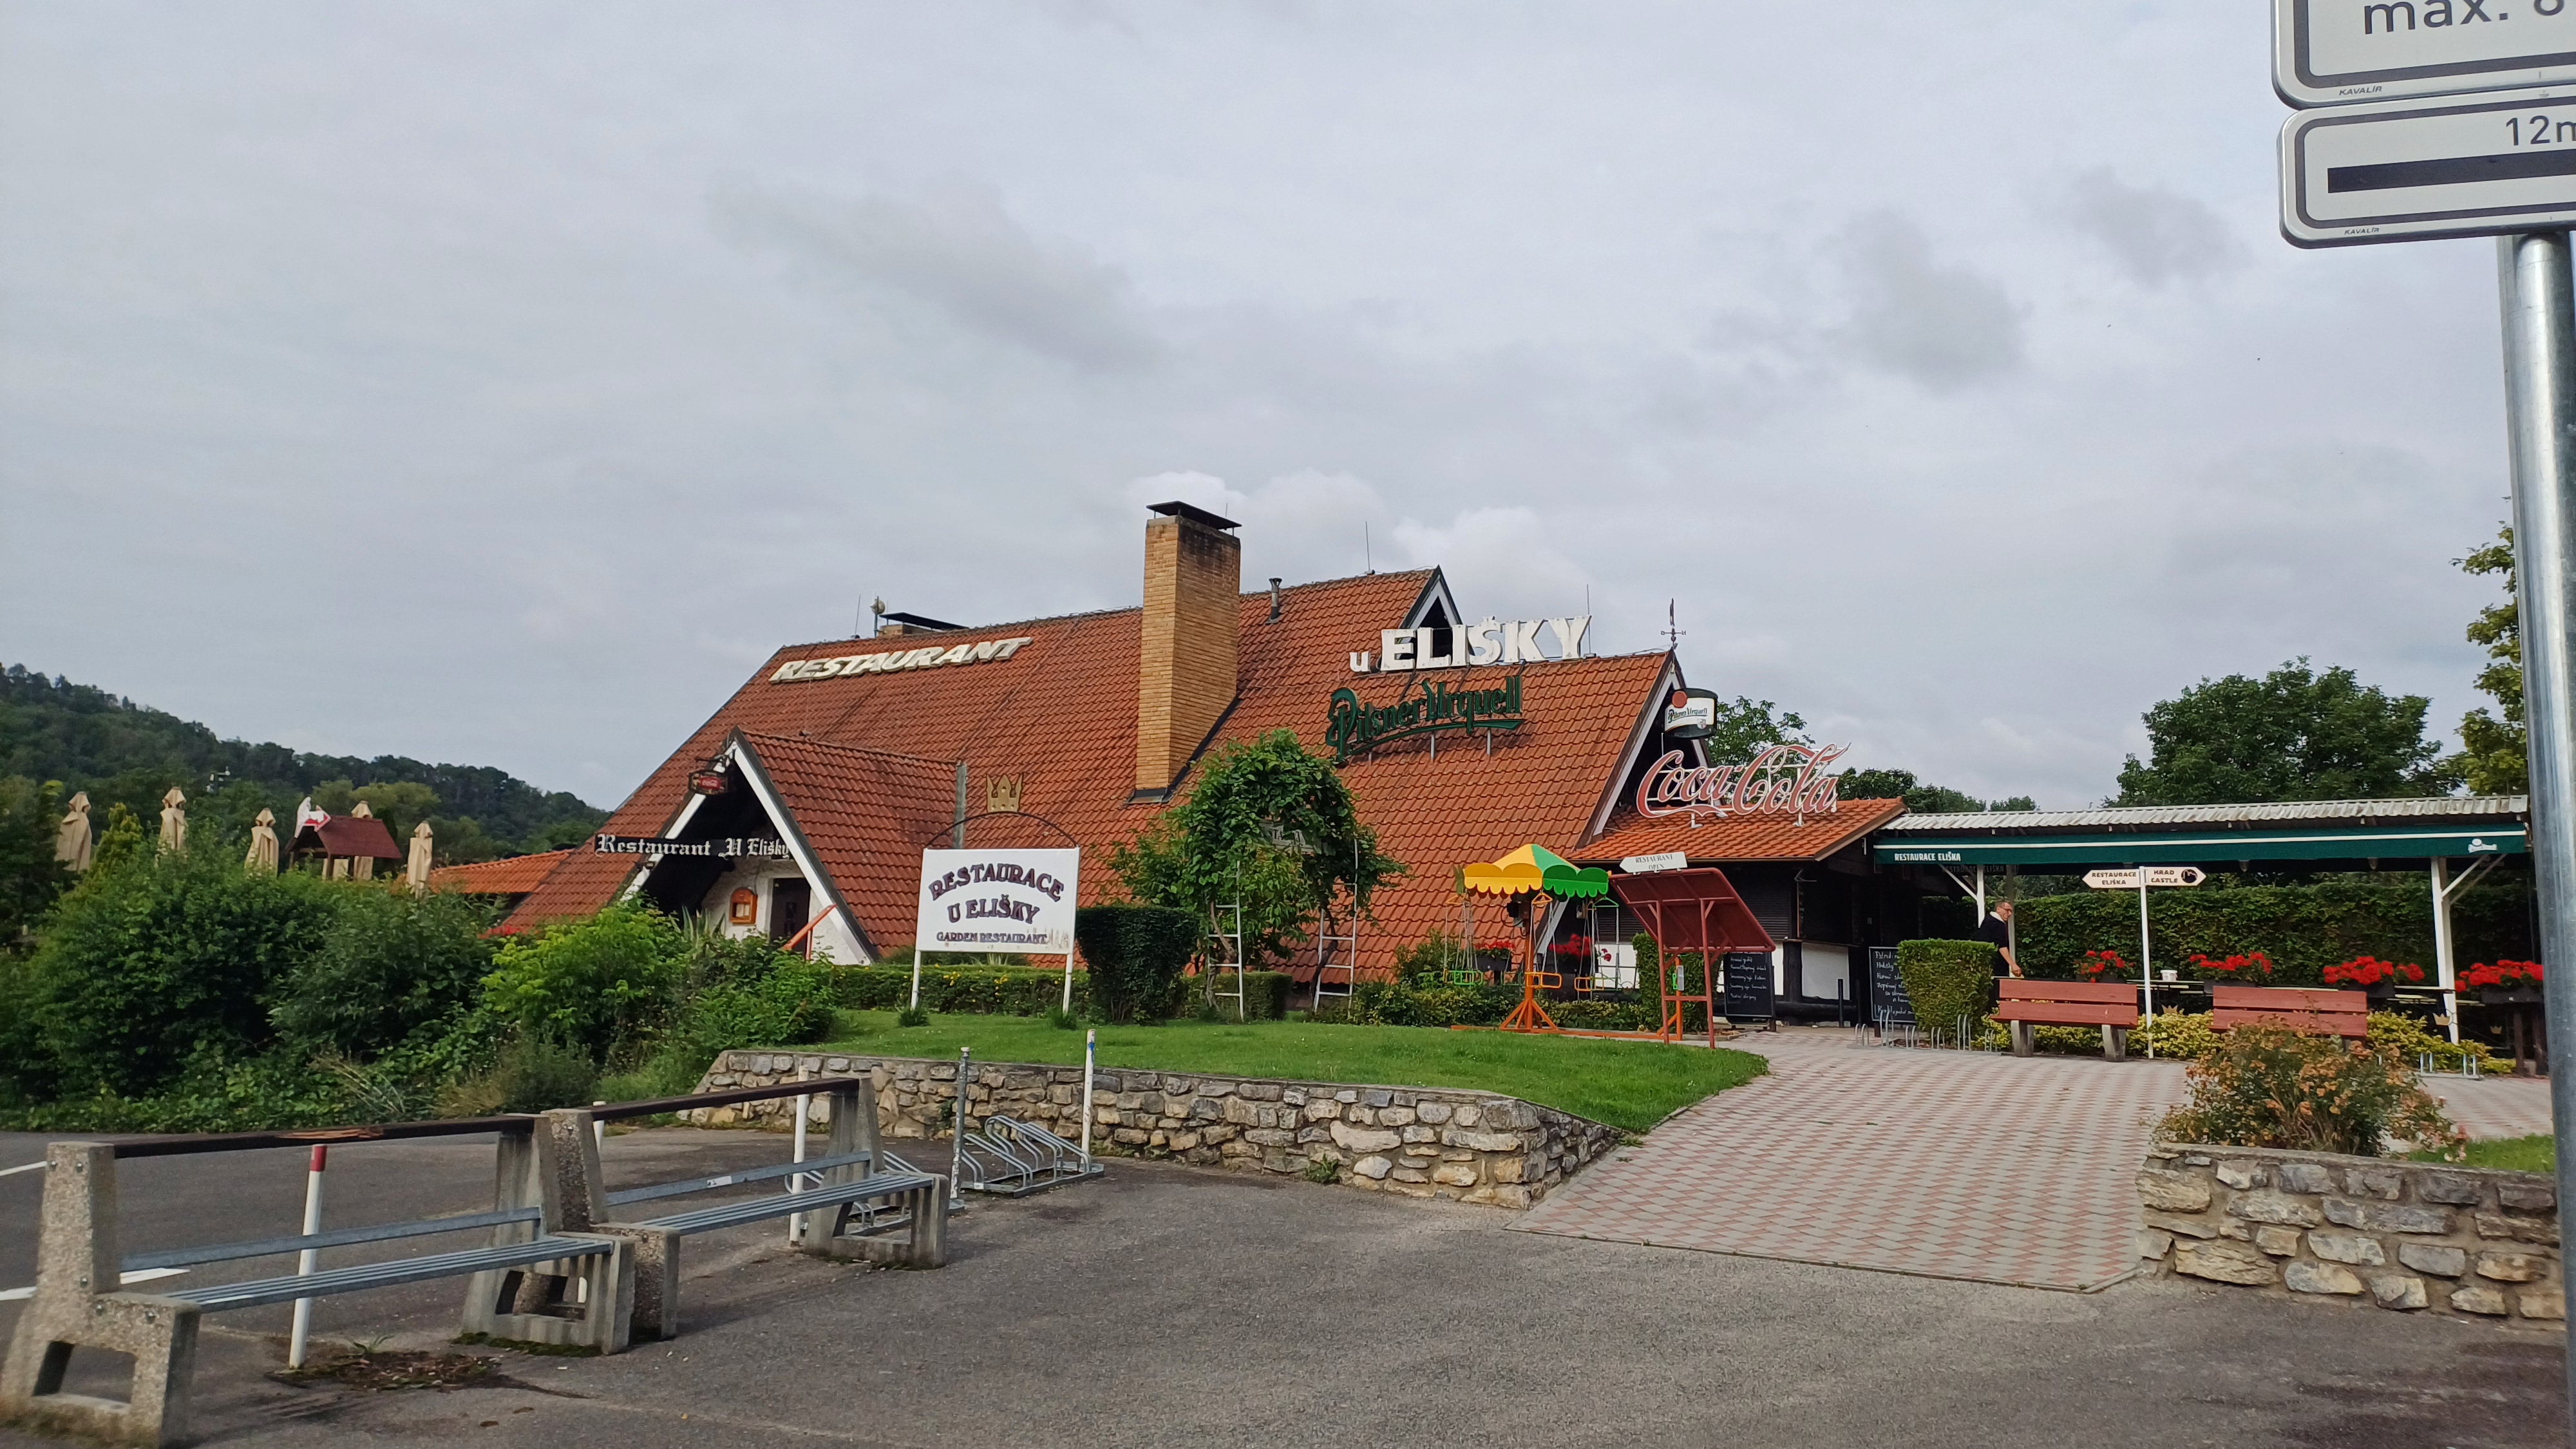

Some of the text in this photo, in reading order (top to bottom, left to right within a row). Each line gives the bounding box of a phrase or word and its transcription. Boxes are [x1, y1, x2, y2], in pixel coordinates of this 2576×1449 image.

[2364, 0, 2508, 34] max.
[768, 636, 1032, 683] RESTAURANT
[1380, 615, 1592, 672] ELIŠKY
[1325, 676, 1522, 762] Pilsner Urquell
[1636, 742, 1852, 818] Coca-Cola
[595, 833, 712, 858] Restaurant
[1635, 854, 1673, 863] RESTAURANT
[1894, 851, 1961, 861] RESTAURACE ELIŠKA
[928, 863, 1064, 902] RESTAURACE
[947, 894, 1039, 924] U ELIŠKY
[936, 932, 1048, 944] GARDEN RESTAURANT
